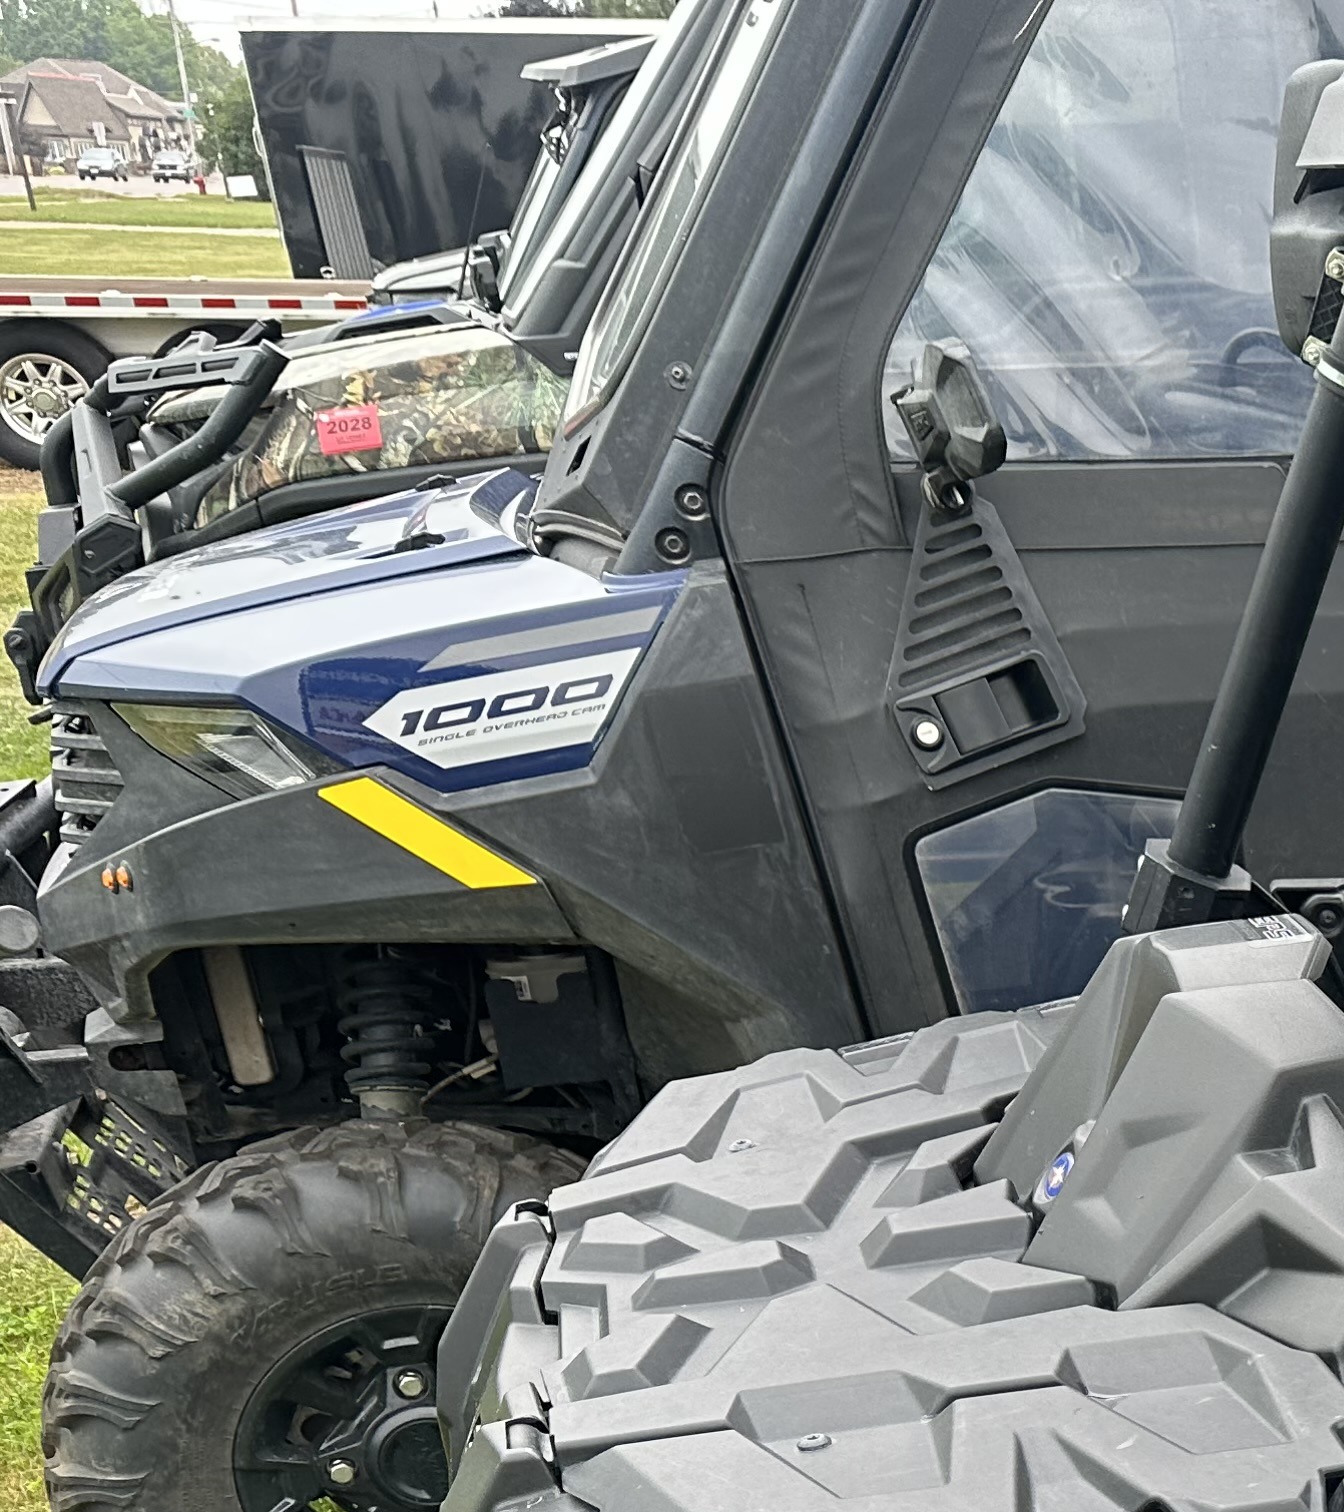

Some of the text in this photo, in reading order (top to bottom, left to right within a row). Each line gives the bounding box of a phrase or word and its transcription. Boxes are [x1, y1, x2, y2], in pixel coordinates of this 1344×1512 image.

[326, 417, 372, 434] 2028
[400, 674, 613, 737] 1000
[418, 703, 607, 746] SINGLE OVERHEAD CAM
